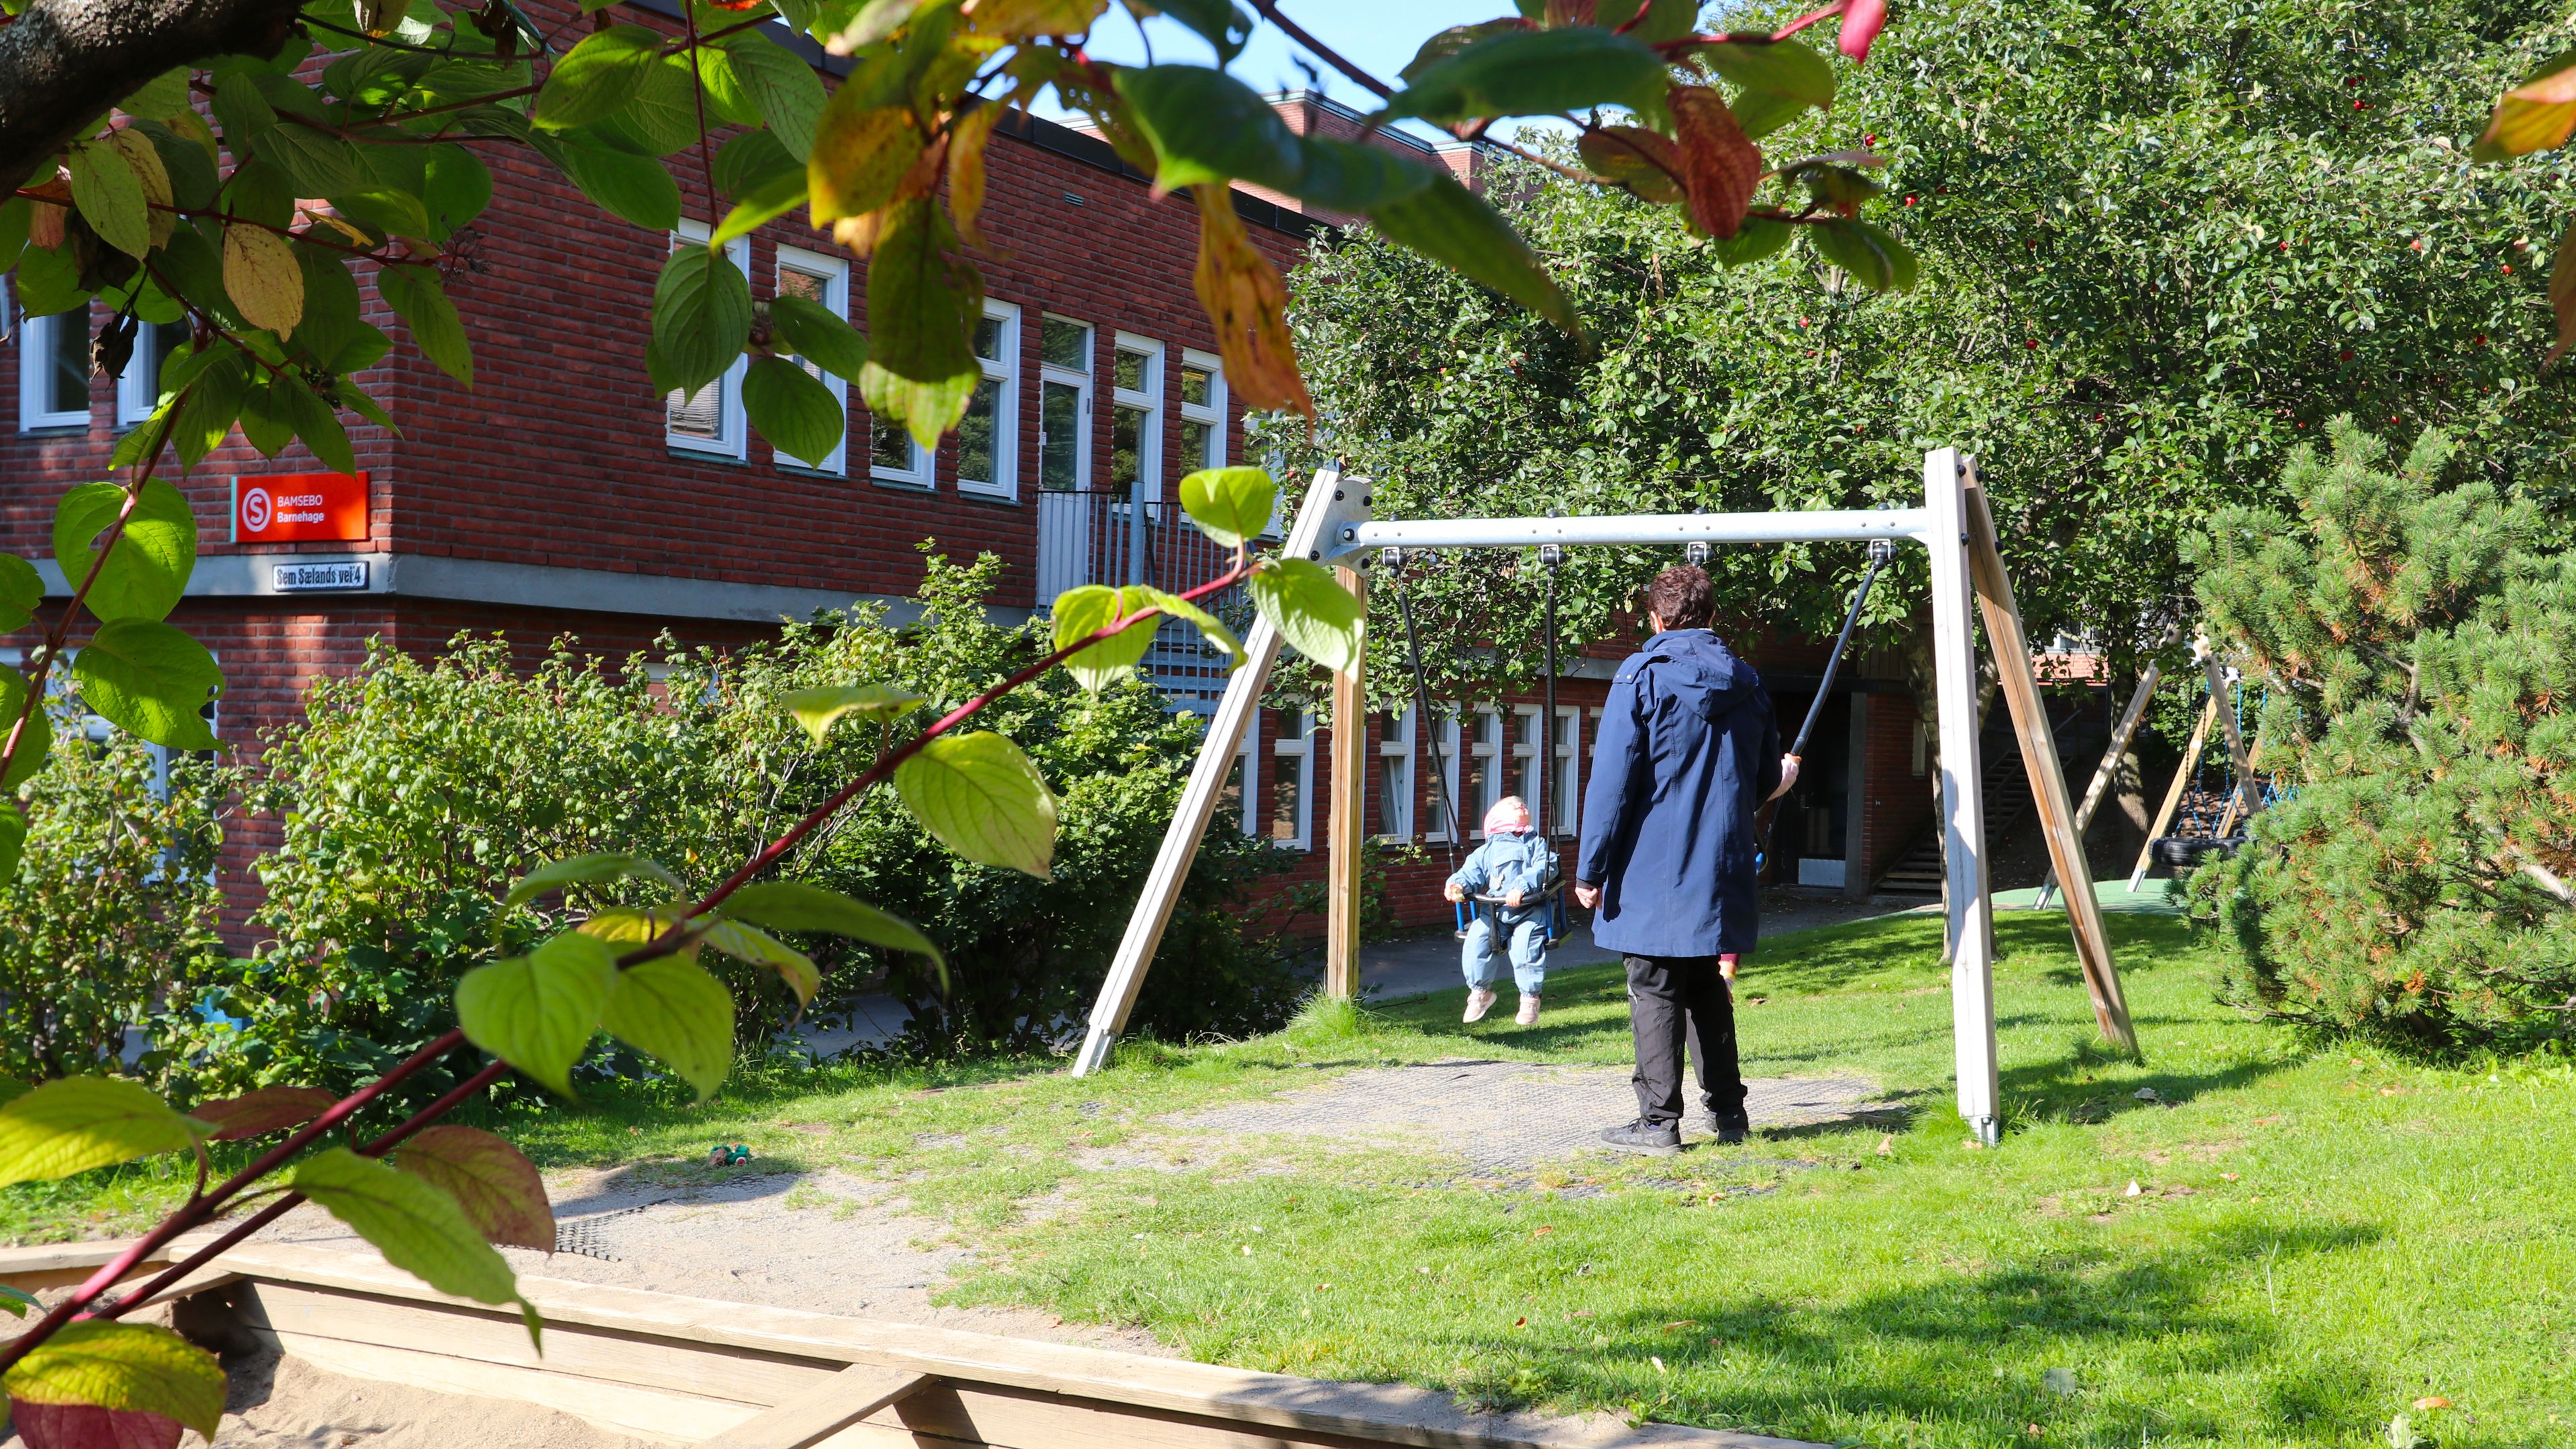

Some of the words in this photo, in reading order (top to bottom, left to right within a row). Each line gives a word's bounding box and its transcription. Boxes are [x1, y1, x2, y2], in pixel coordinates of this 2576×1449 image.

[277, 494, 323, 507] BAMSEBO
[250, 496, 264, 524] S
[277, 511, 325, 524] Barnehage
[276, 569, 296, 585] Sem
[299, 566, 336, 585] Sælands
[339, 566, 354, 584] vei
[354, 566, 361, 583] 4
